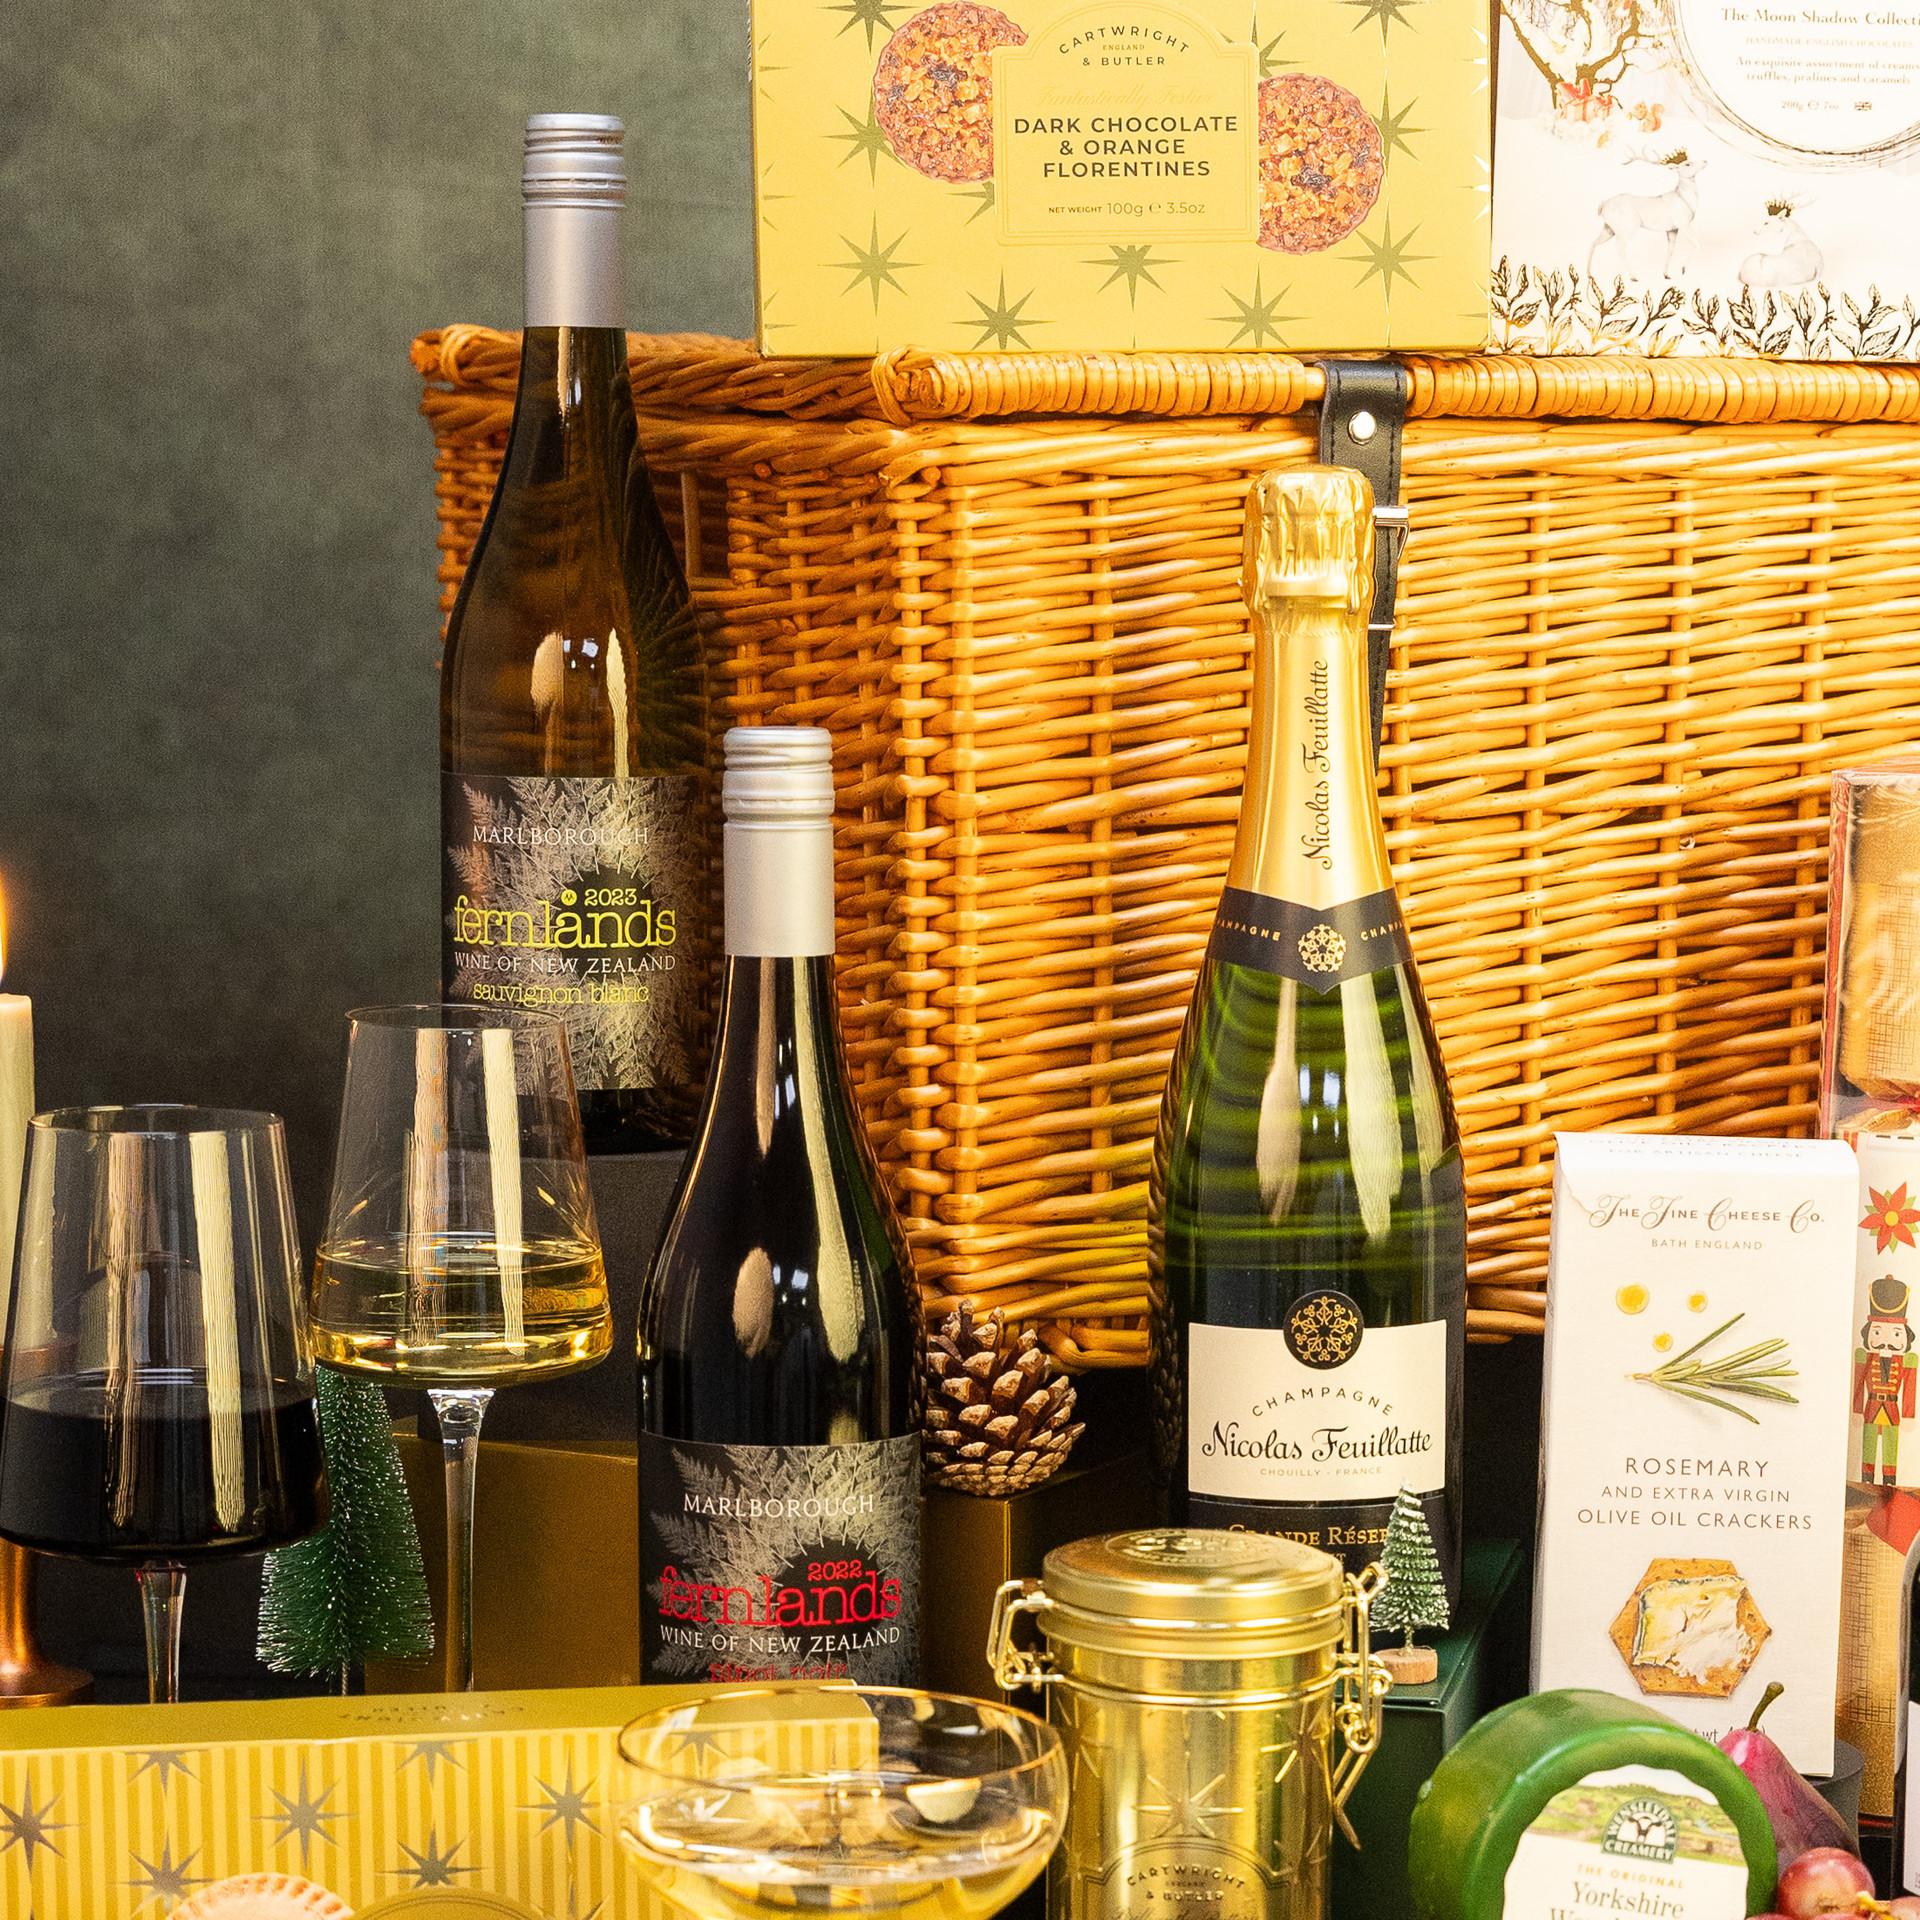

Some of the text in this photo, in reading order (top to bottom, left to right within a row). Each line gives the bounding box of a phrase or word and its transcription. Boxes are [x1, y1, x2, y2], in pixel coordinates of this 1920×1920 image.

[1721, 8, 1749, 22] The
[1754, 9, 1796, 23] Moon
[1802, 10, 1858, 25] Shadow
[1059, 26, 1189, 54] CARTWRIGHT
[1082, 56, 1166, 66] & BUTLER
[1736, 57, 1751, 66] An
[1754, 59, 1801, 69] exquisite
[1806, 60, 1865, 69] assortment
[1868, 60, 1879, 69] of
[1747, 72, 1911, 84] truffles, pralines and caramels
[1014, 116, 1238, 134] DARK CHOCOLATE
[1059, 139, 1186, 155] & ORANGE
[1044, 161, 1210, 178] FLORENTINES
[1106, 203, 1143, 217] 100g
[1166, 203, 1206, 214] 3.5oz
[1300, 657, 1333, 870] Nicolas Feuillatte
[473, 825, 648, 846] MARLBOROUGH
[584, 888, 637, 906] 2023
[453, 894, 677, 949] fernlands
[455, 952, 676, 974] WINE OF NEW ZEALAND
[473, 982, 649, 1007] sauvignon blanc
[1651, 1238, 1762, 1250] BATH ENGLAND
[1252, 1387, 1393, 1417] CHAMPAGNE
[1201, 1421, 1433, 1462] Nicolas Feuillatte
[1260, 1467, 1321, 1476] CHOUILLY
[1336, 1466, 1382, 1476] FRANCE
[1625, 1457, 1769, 1478] ROSEMARY
[1601, 1486, 1790, 1503] AND EXTRA VIRGIN
[683, 1493, 874, 1518] MARLBOROUGH
[1578, 1509, 1812, 1530] OLIVE OIL CRACKERS
[807, 1560, 862, 1581] 2022
[659, 1565, 901, 1627] fernlands
[660, 1624, 900, 1653] WINE OF NEW ZEALAND
[1605, 1840, 1672, 1860] CREAMERY
[1127, 1864, 1245, 1888] CARTWRIGHT
[1577, 1864, 1684, 1890] THE ORIGINAL
[1573, 1880, 1685, 1919] Yorkshire
